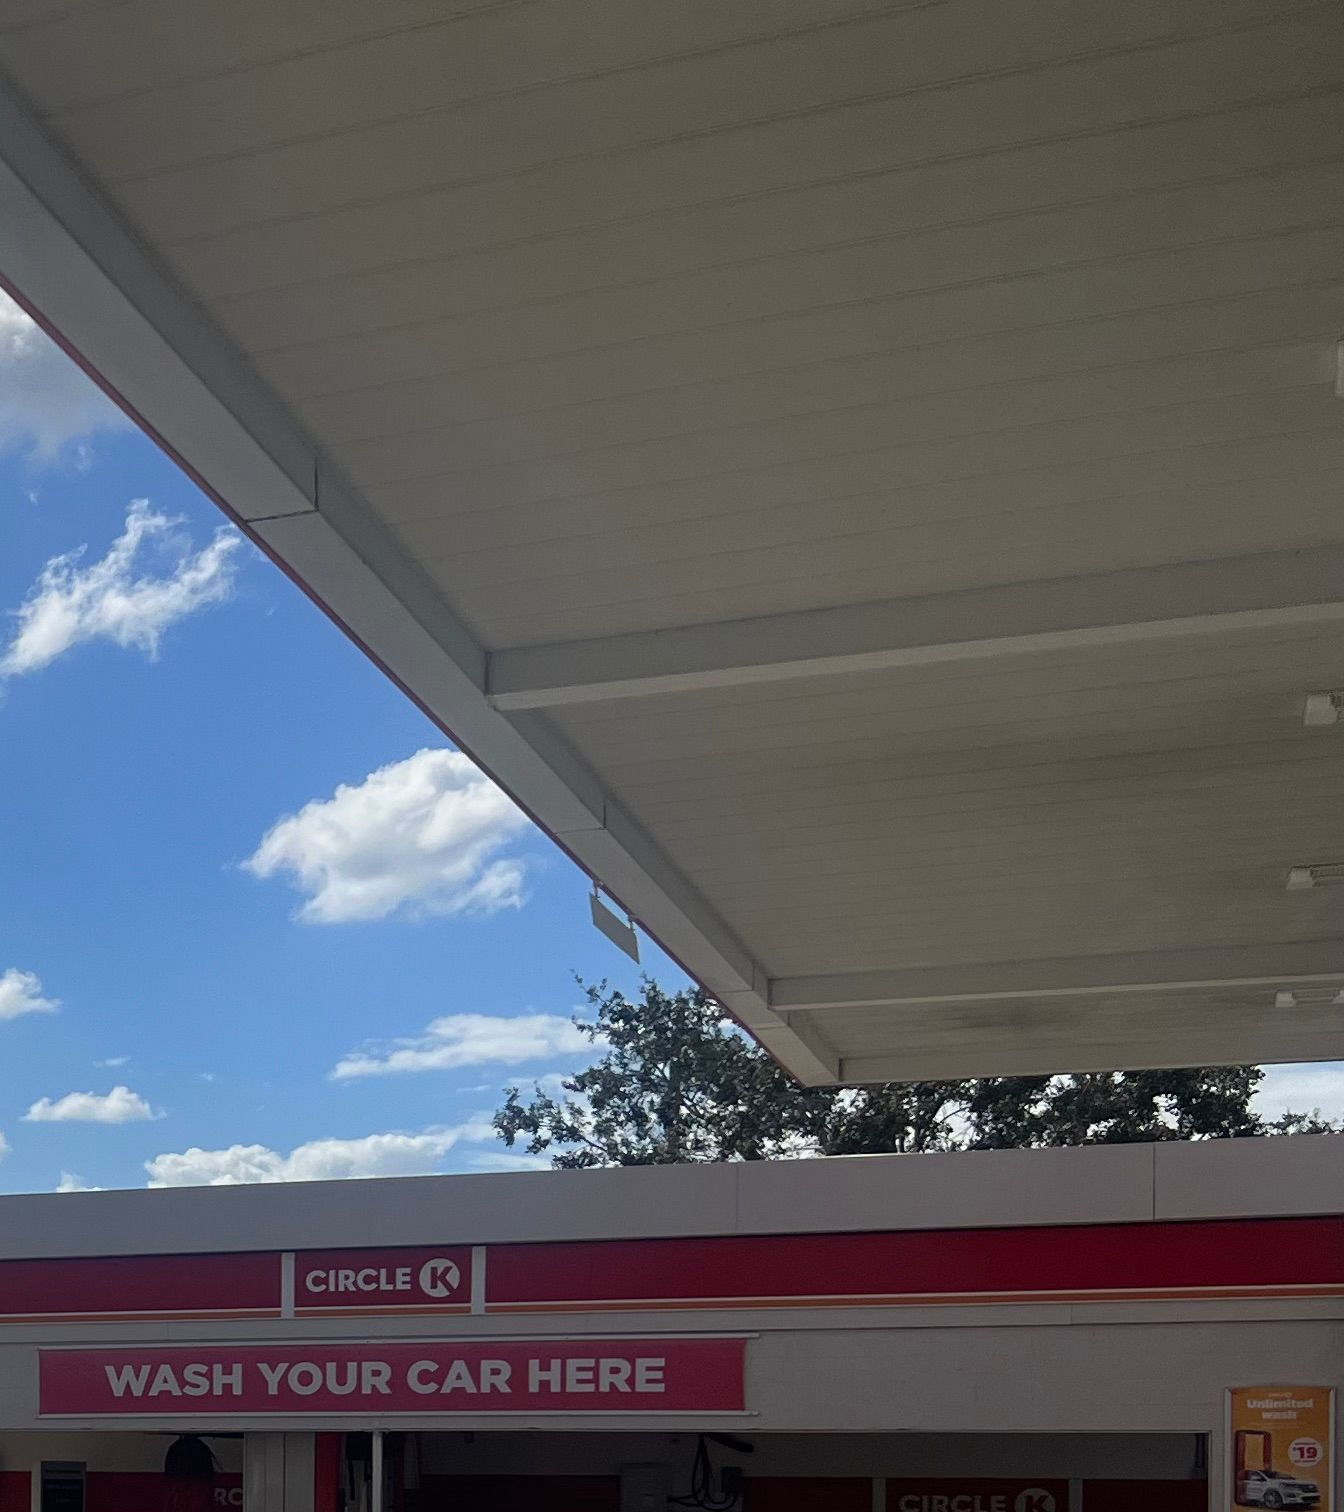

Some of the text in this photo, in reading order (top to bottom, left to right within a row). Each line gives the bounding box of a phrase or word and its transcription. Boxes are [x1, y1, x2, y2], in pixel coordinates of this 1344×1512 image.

[306, 1258, 460, 1298] CIRCLE K
[104, 1357, 665, 1397] WASH YOUR CAR HERE
[1247, 1398, 1314, 1408] Unlimited
